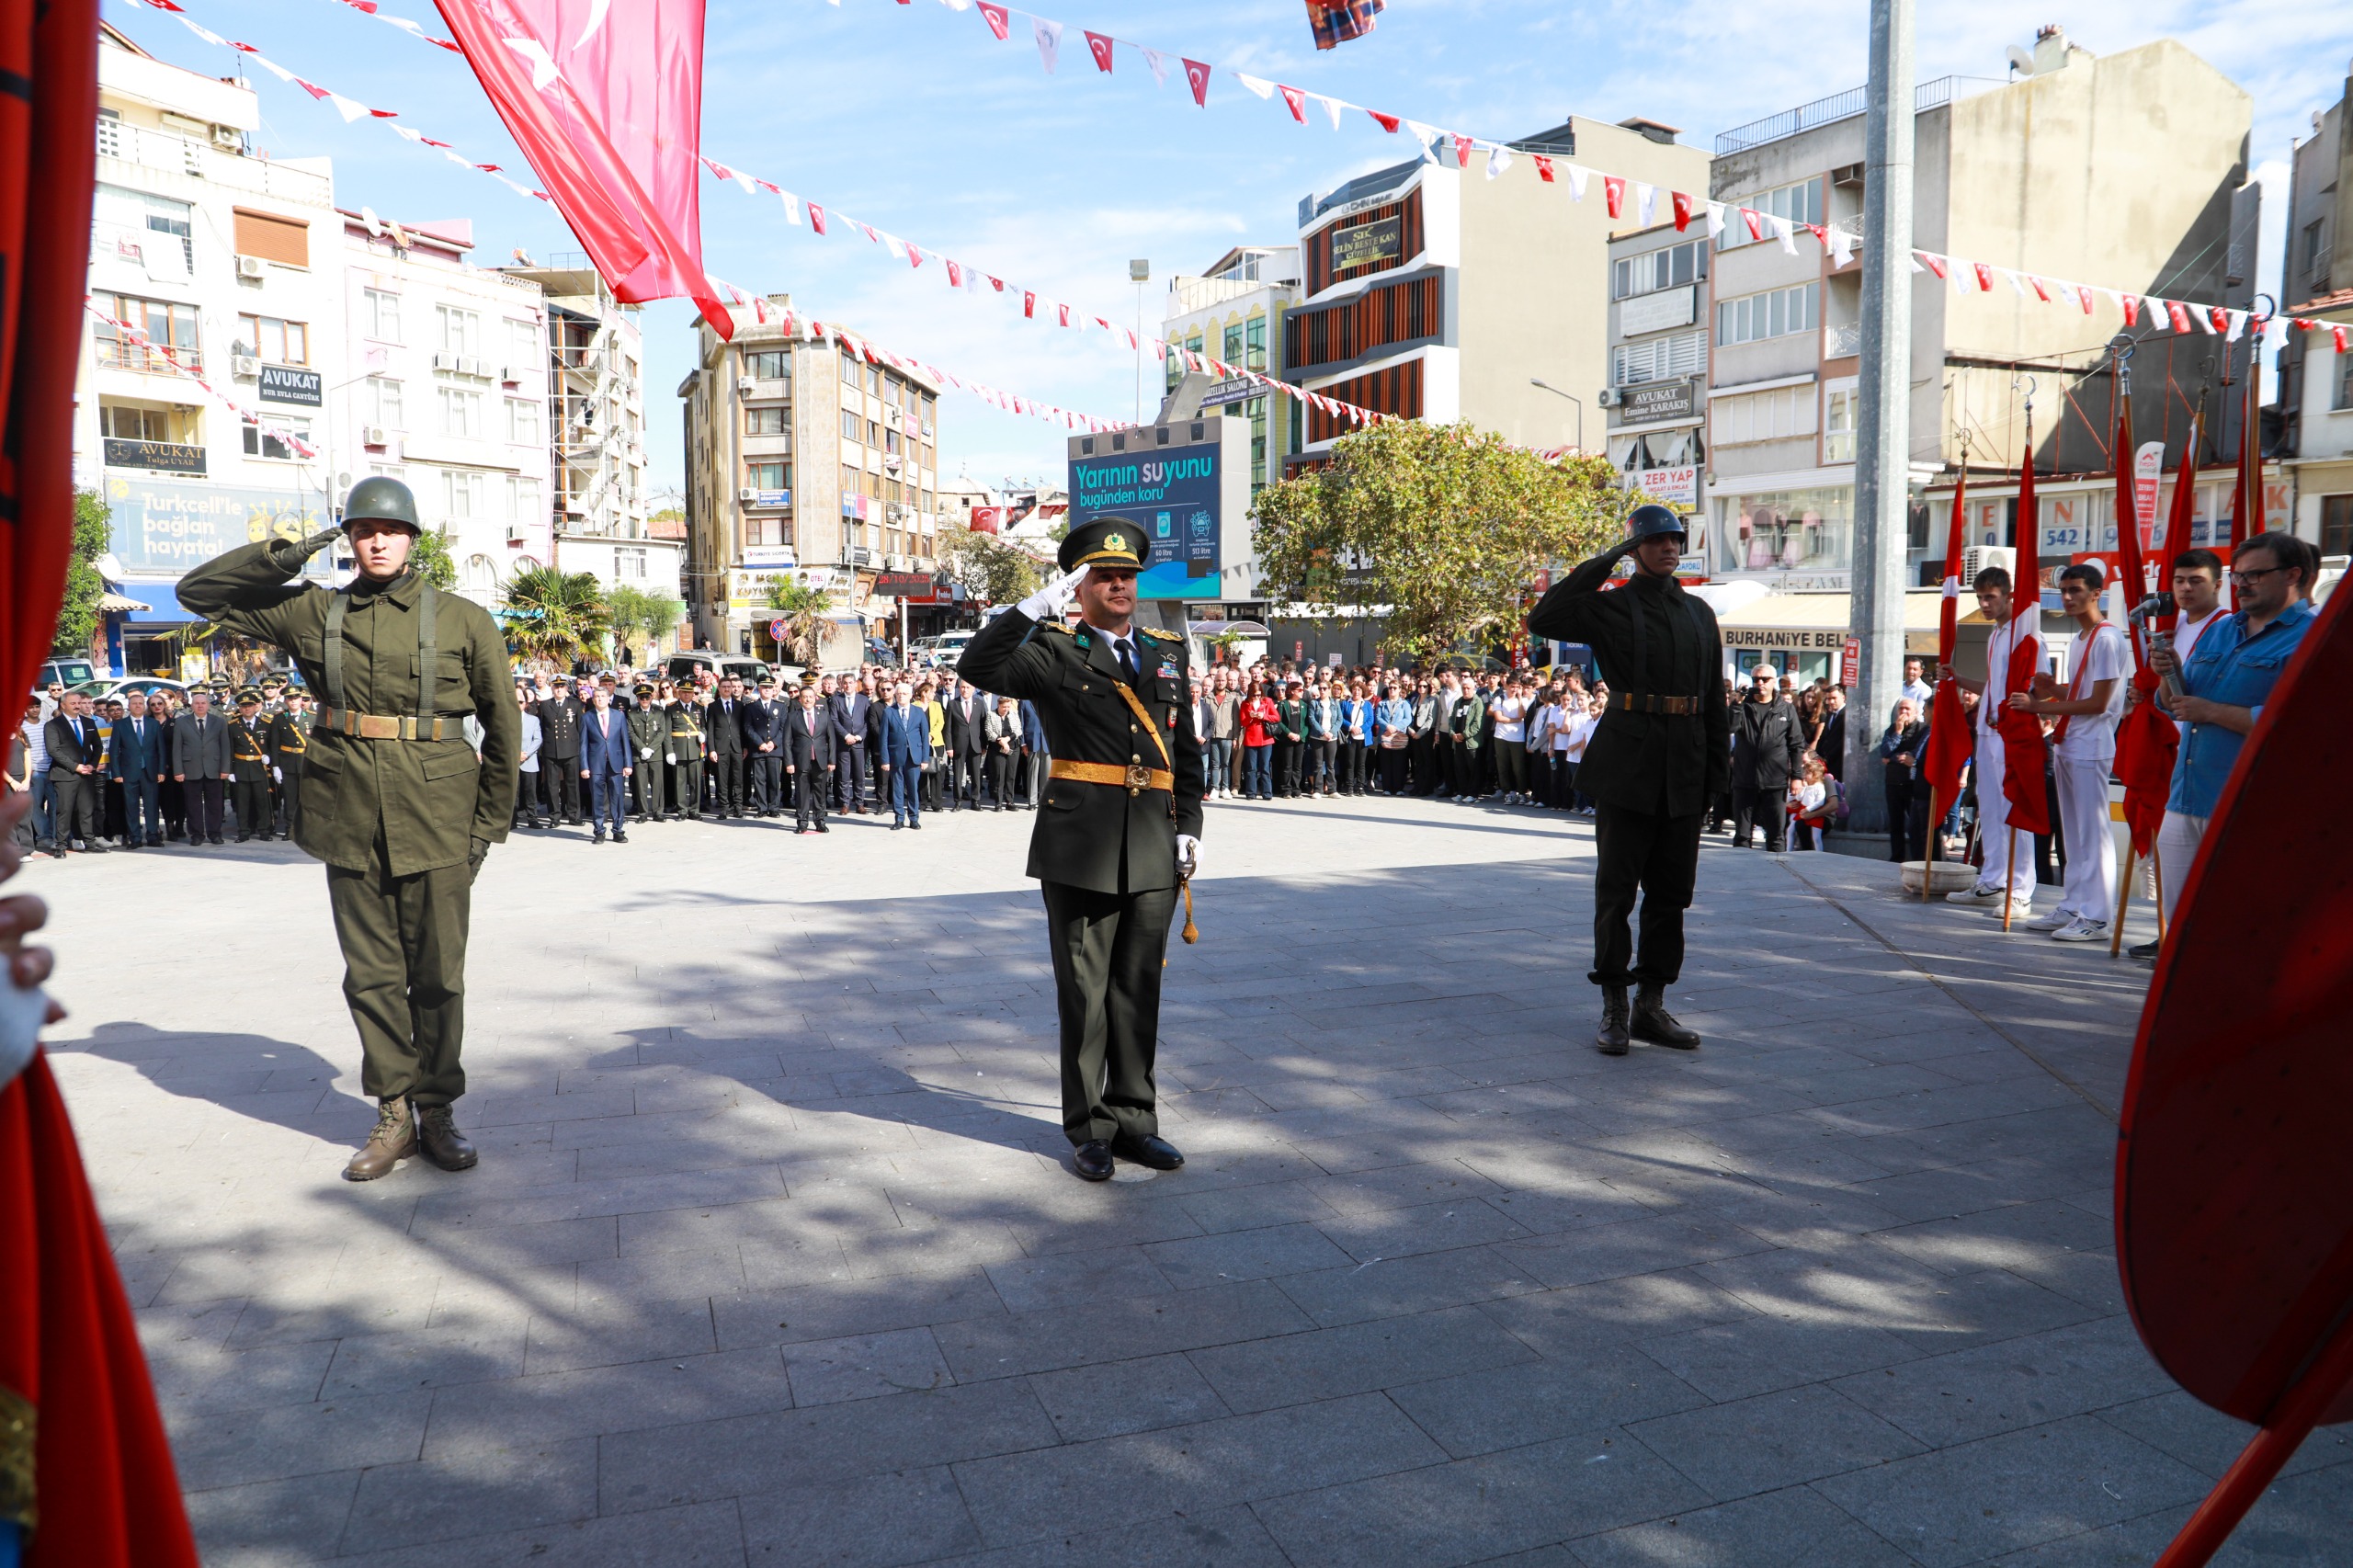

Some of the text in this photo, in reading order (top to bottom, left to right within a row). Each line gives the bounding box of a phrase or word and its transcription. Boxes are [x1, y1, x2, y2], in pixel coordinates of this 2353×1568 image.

[1355, 237, 1379, 249] BESTE
[1380, 233, 1396, 244] KAN
[263, 369, 319, 390] AVUKAT
[1206, 383, 1226, 396] ÜZELLİK
[1227, 379, 1248, 392] SALONU
[293, 392, 320, 402] CANTÜRK
[1635, 388, 1678, 403] AVUKAT
[1624, 399, 1688, 416] Emine KARAKIŞ
[139, 444, 203, 459] AVUKAT
[146, 456, 195, 466] Tulga UYAR
[1076, 457, 1212, 489] Yarının suyunu
[1645, 470, 1694, 485] ZER YAP
[142, 492, 243, 516] Turkcell'le
[1080, 486, 1164, 510] bugünden koru
[142, 513, 215, 538] bağlan
[2046, 528, 2078, 546] 542
[143, 535, 223, 559] hayata!
[879, 574, 930, 584] 28/10/2025
